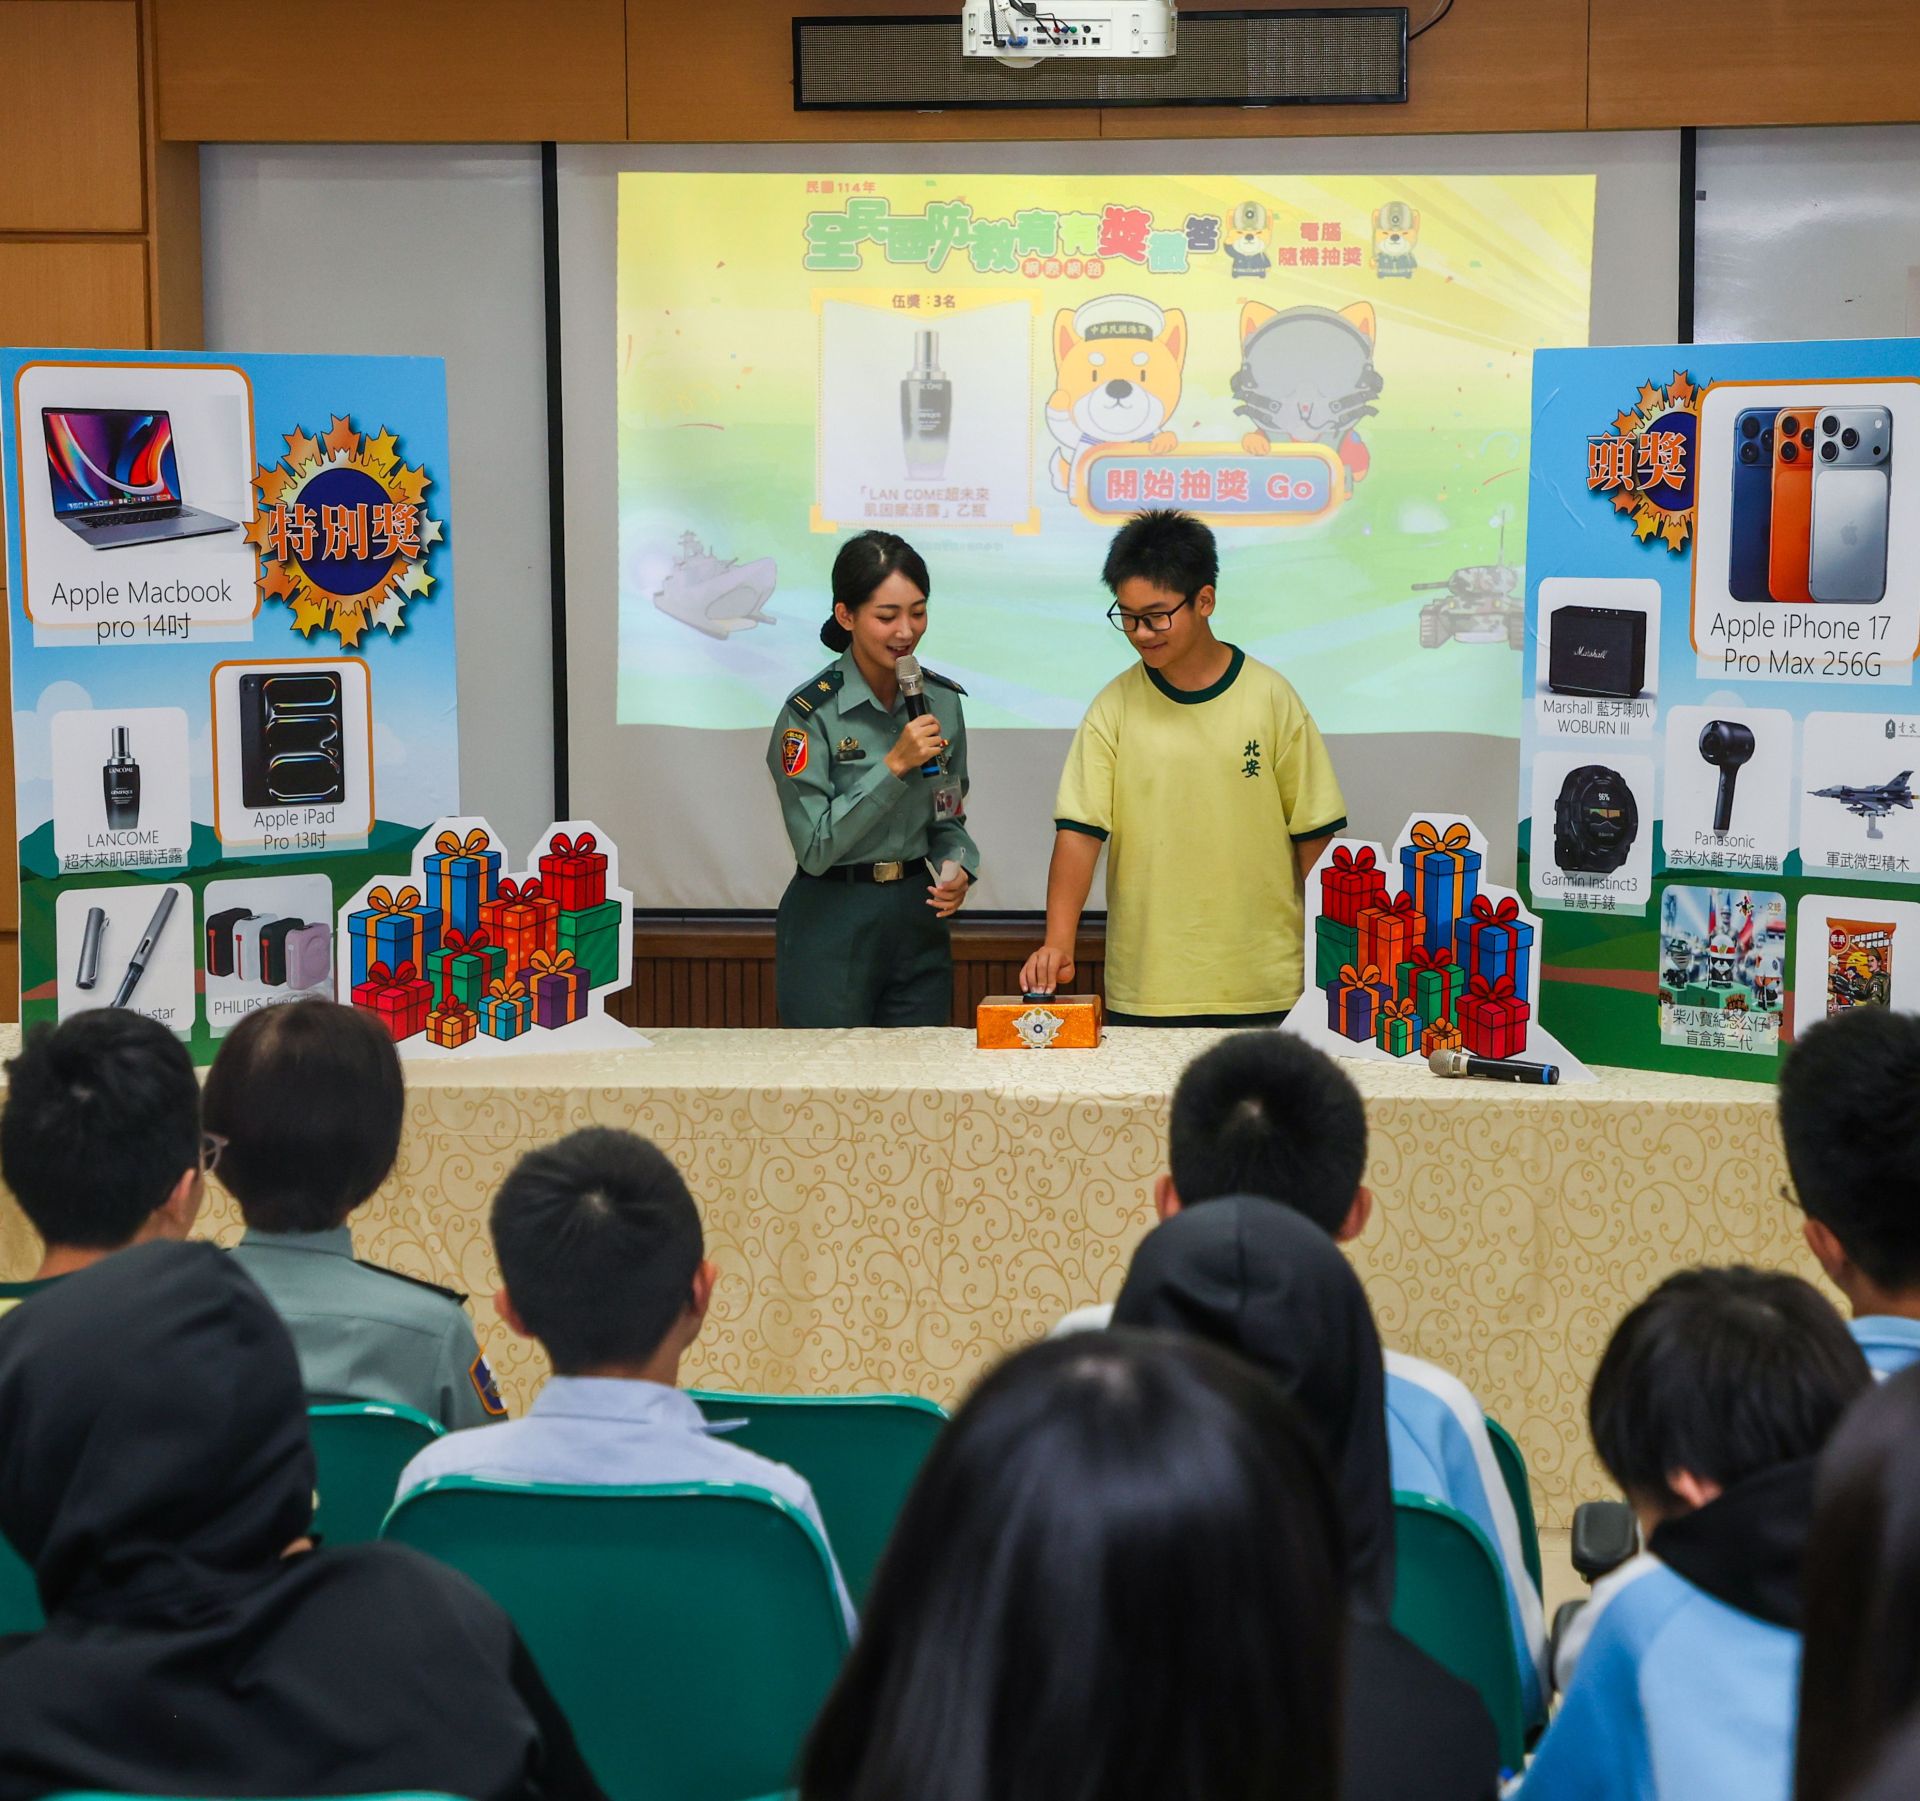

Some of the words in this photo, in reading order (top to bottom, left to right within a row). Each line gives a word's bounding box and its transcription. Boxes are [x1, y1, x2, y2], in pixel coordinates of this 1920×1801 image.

[1300, 222, 1341, 242] 電腦
[1278, 246, 1362, 267] 隨機抽獎
[1586, 430, 1687, 492] 頭獎
[1106, 469, 1248, 500] 開始抽獎
[1266, 474, 1313, 499] Go
[267, 502, 421, 562] 特別獎
[51, 581, 119, 612] Apple
[128, 578, 232, 604] Macbook
[97, 620, 135, 644] pro
[143, 612, 191, 639] 14吋
[1710, 612, 1775, 643] Apple
[1783, 613, 1860, 640] iPhone
[1868, 615, 1891, 640] 17
[1724, 648, 1760, 673] Pro
[1769, 650, 1815, 674] Max
[1822, 651, 1881, 677] 256G
[1543, 699, 1593, 715] Marshall
[1596, 700, 1650, 718] 藍牙喇叭
[1557, 719, 1616, 735] WOBURN
[1241, 739, 1261, 778] 北安
[254, 809, 299, 831] Apple
[304, 806, 335, 824] iPad
[88, 830, 159, 847] LANCOME
[264, 834, 290, 850] Pro
[294, 830, 326, 849] 13吋
[1694, 831, 1756, 849] Panasonic
[64, 847, 183, 870] 超未來肌因賦活露
[1670, 849, 1779, 871] 奈米水離子吹風機
[1826, 851, 1910, 872] 軍武微型積木
[1542, 872, 1584, 887] Garmin
[1588, 876, 1638, 891] Instinct3
[1563, 891, 1615, 911] 智慧手錶
[214, 997, 262, 1015] PHILIPS
[1673, 1009, 1767, 1033] 柴小寶紀念公仔
[1686, 1030, 1753, 1051] 盲盒第二代
